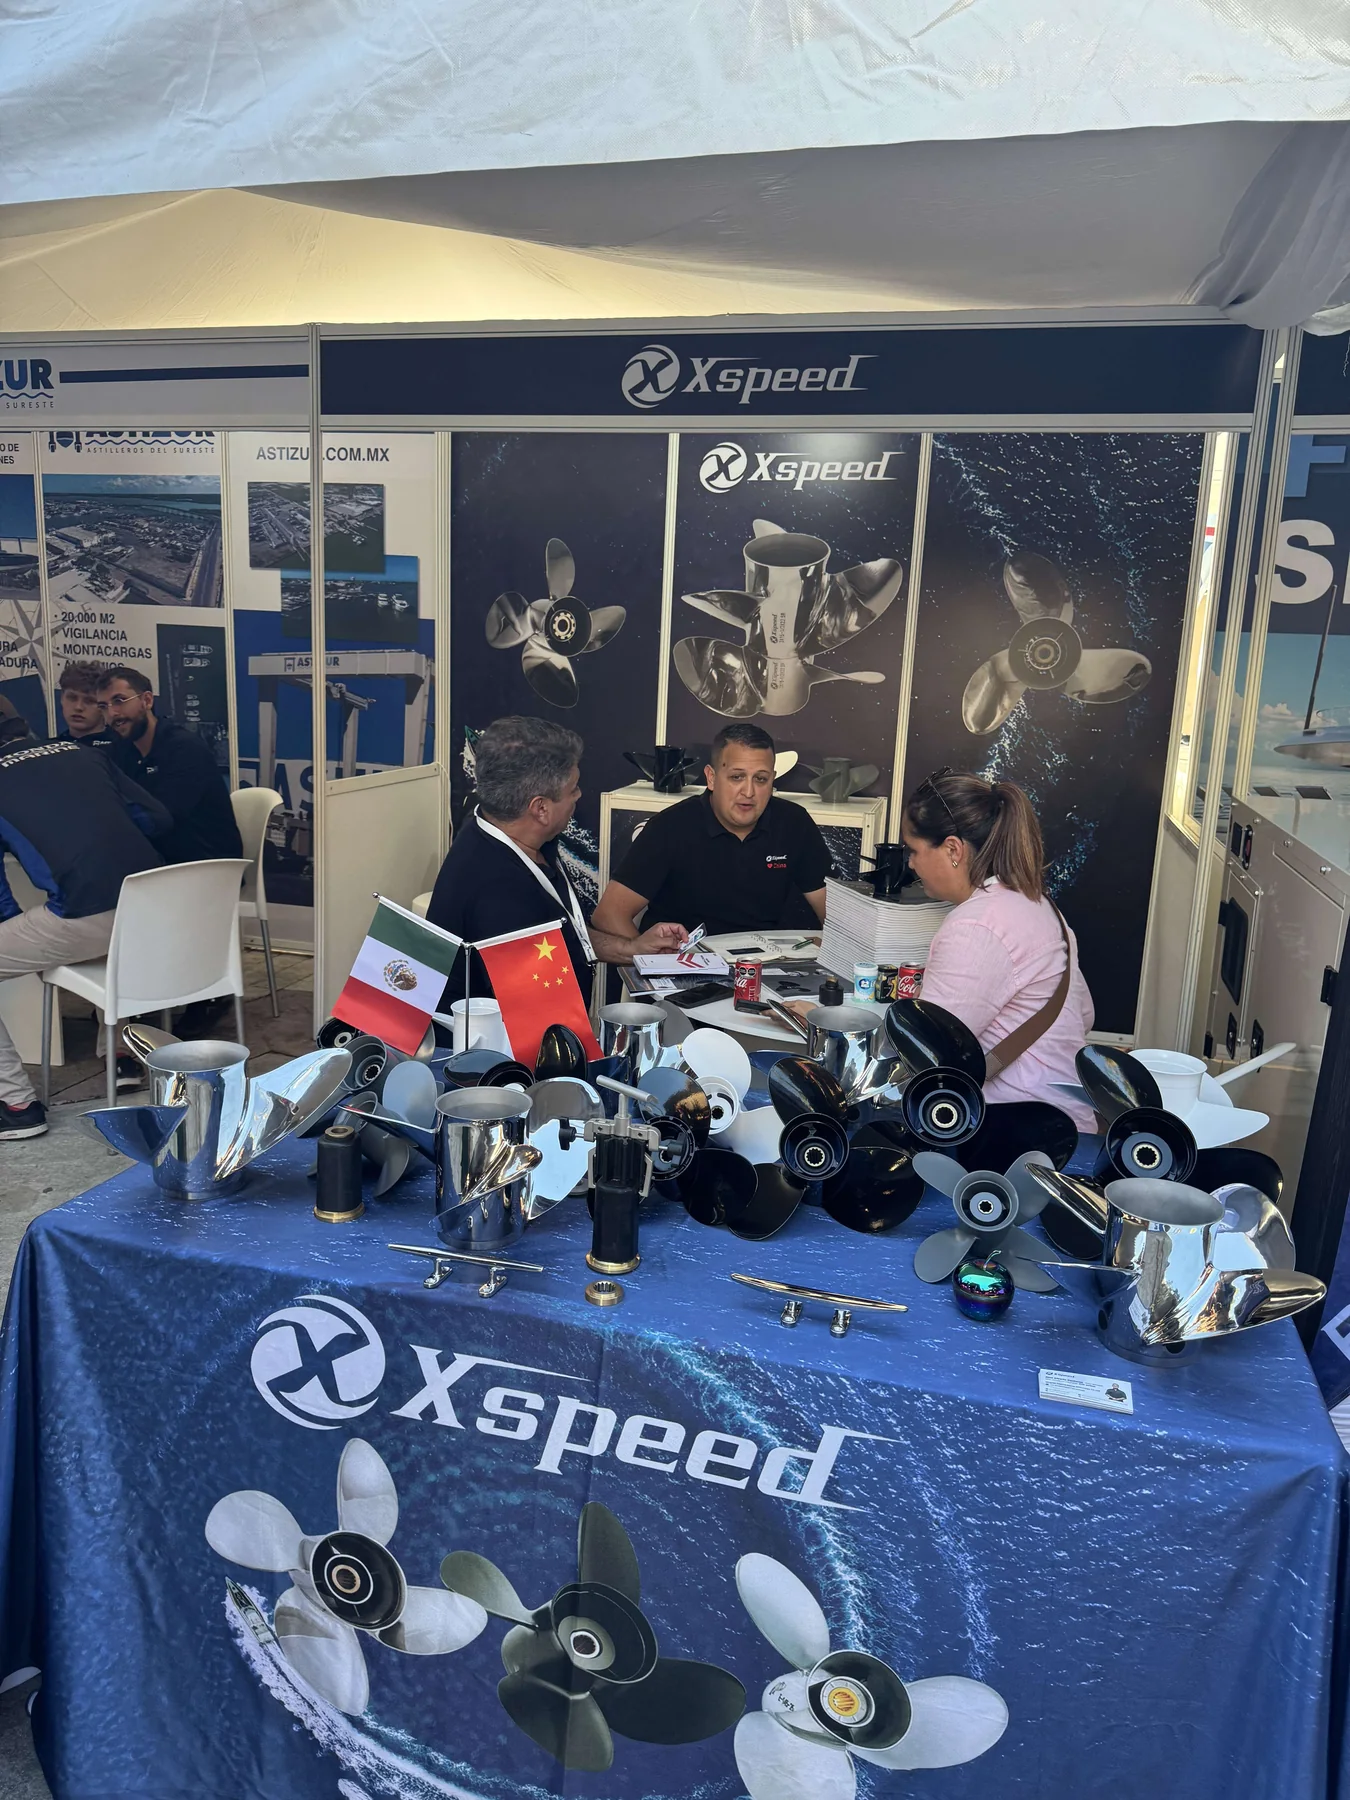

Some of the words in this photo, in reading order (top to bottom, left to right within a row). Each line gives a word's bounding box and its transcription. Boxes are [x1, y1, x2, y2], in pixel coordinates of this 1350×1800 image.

[0, 359, 54, 390] UR
[681, 354, 879, 404] Xspeed
[6, 401, 54, 409] SURESTE
[8, 443, 19, 452] DE
[256, 446, 390, 462] ASTIZU.COM.MX
[747, 451, 905, 491] Xspeed
[61, 611, 97, 624] 20,000
[99, 613, 115, 624] M2
[62, 627, 128, 642] VIGILANCIA
[63, 643, 153, 659] MONTACARGAS
[390, 1344, 903, 1513] Xspeed
